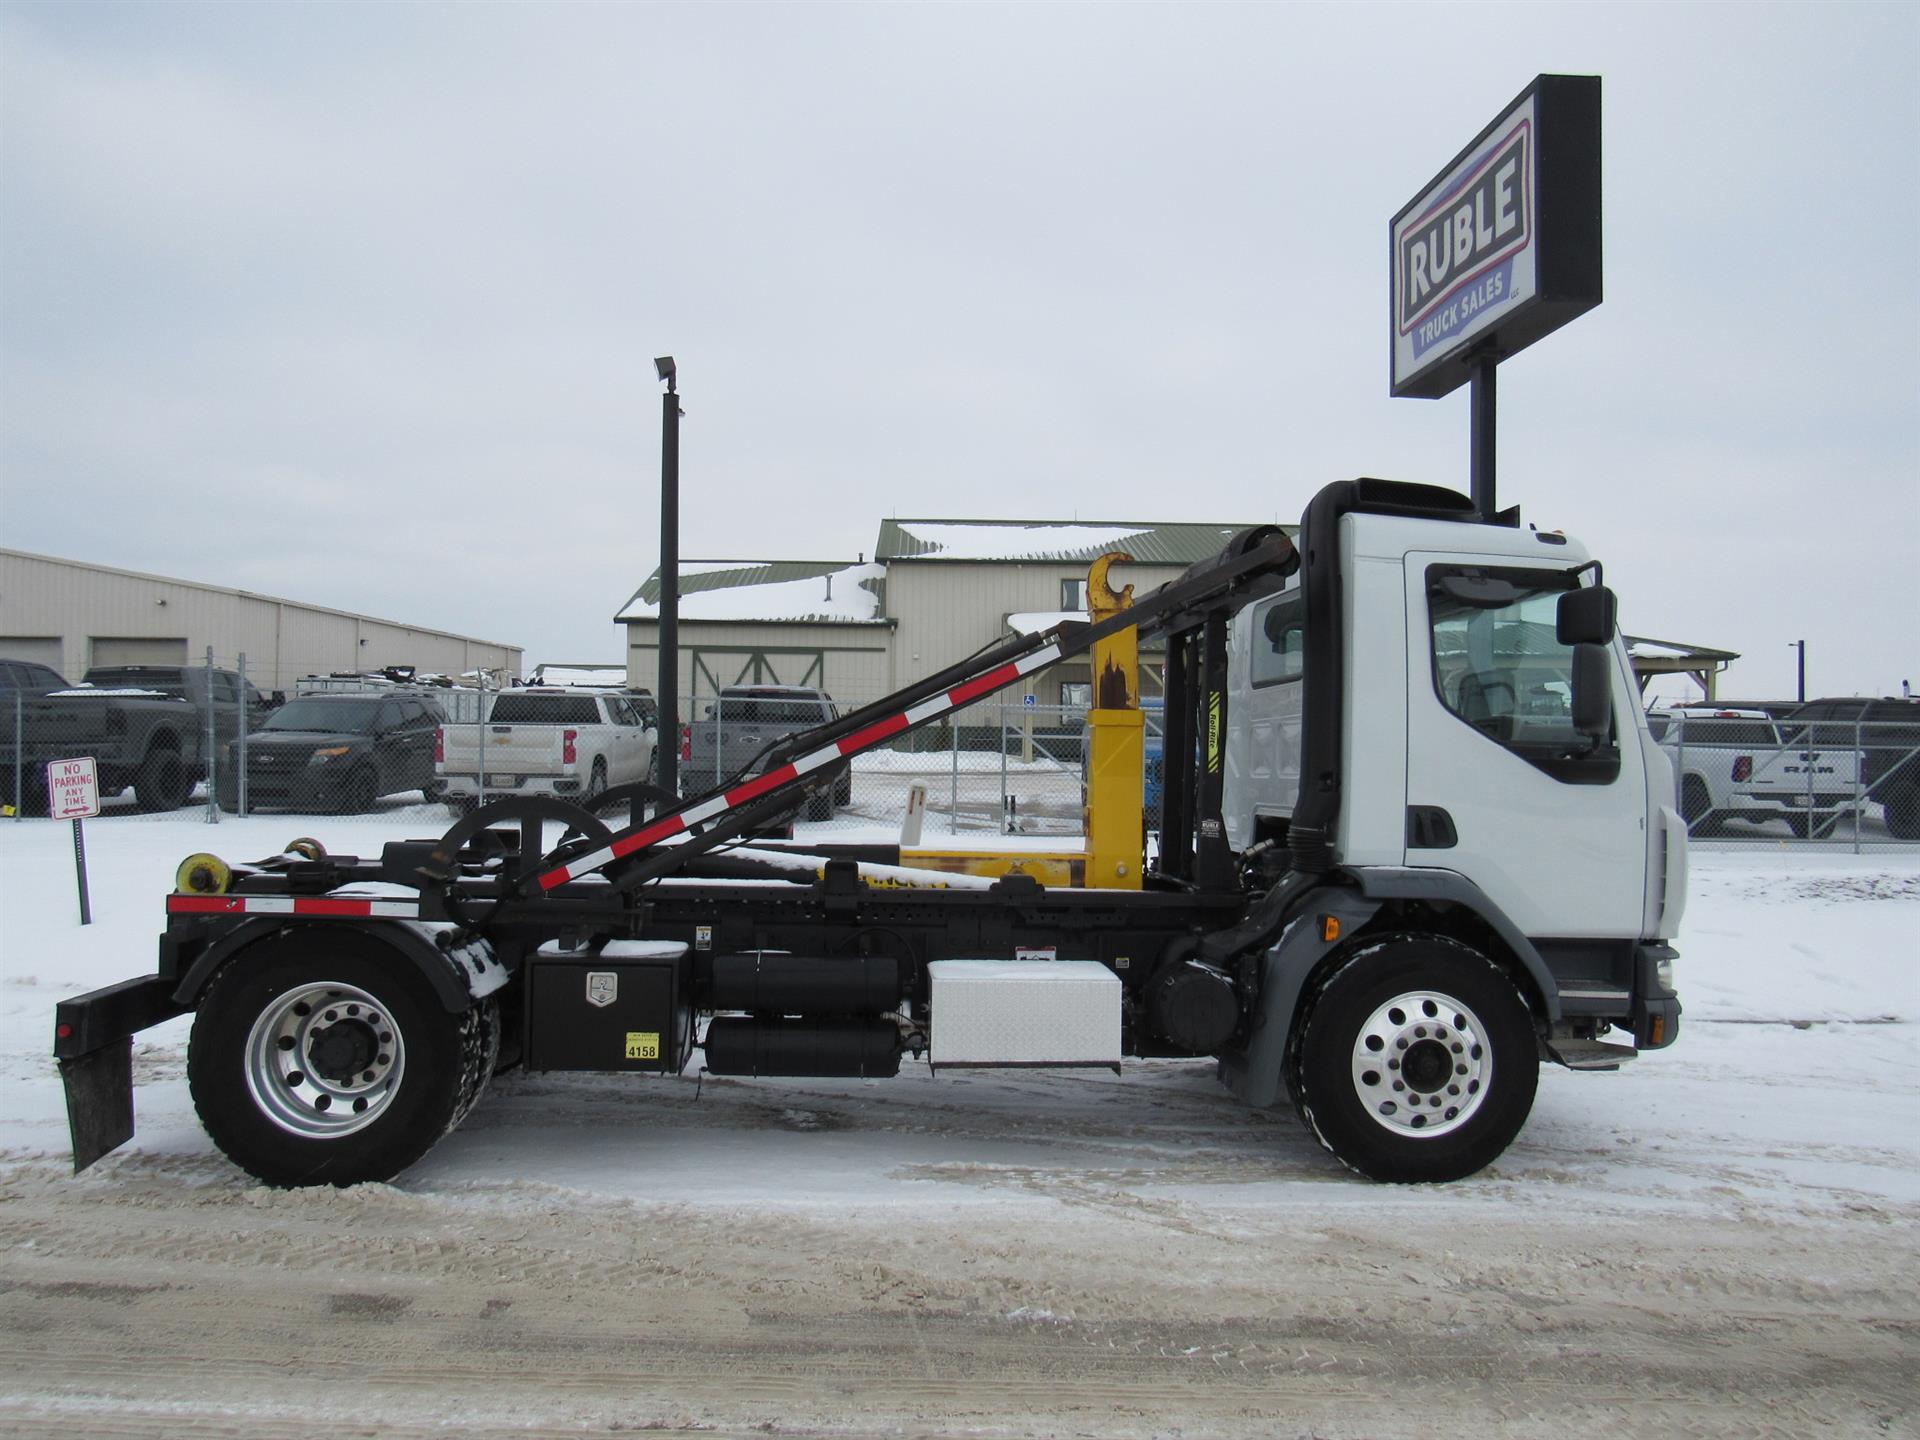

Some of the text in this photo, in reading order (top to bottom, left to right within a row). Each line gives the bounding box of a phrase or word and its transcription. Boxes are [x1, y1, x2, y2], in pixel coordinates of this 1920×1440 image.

[1410, 157, 1516, 306] RUBLE
[1419, 271, 1503, 347] TRUCK SALES
[64, 764, 80, 775] NO
[1783, 766, 1834, 774] RAM
[55, 774, 92, 788] PARKING
[65, 787, 83, 797] ANY
[65, 796, 86, 806] TIME
[629, 1046, 655, 1057] 4158
